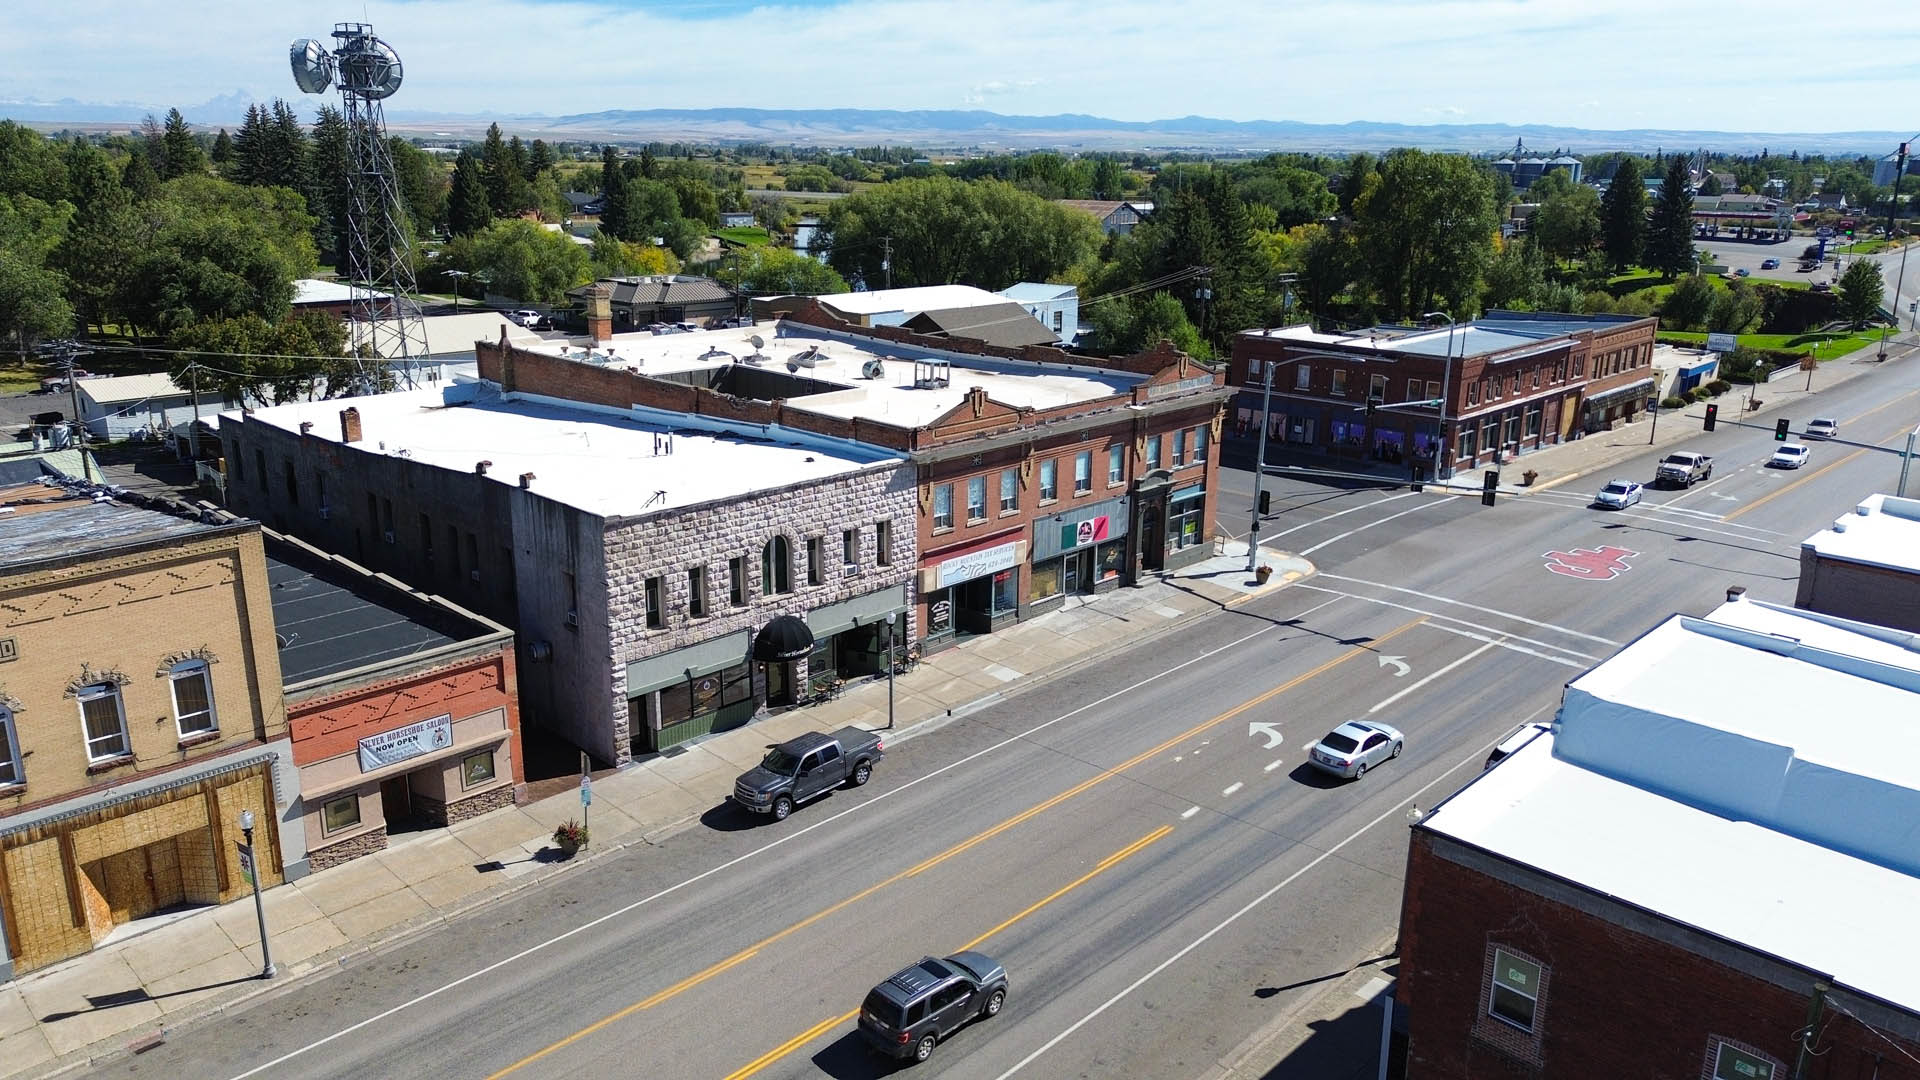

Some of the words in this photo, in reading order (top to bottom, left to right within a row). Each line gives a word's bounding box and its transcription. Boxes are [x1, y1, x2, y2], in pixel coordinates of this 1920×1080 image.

[387, 725, 424, 741] HORSESHOE
[426, 716, 449, 730] SALOON
[375, 742, 395, 753] NOW
[397, 734, 419, 746] OPEN
